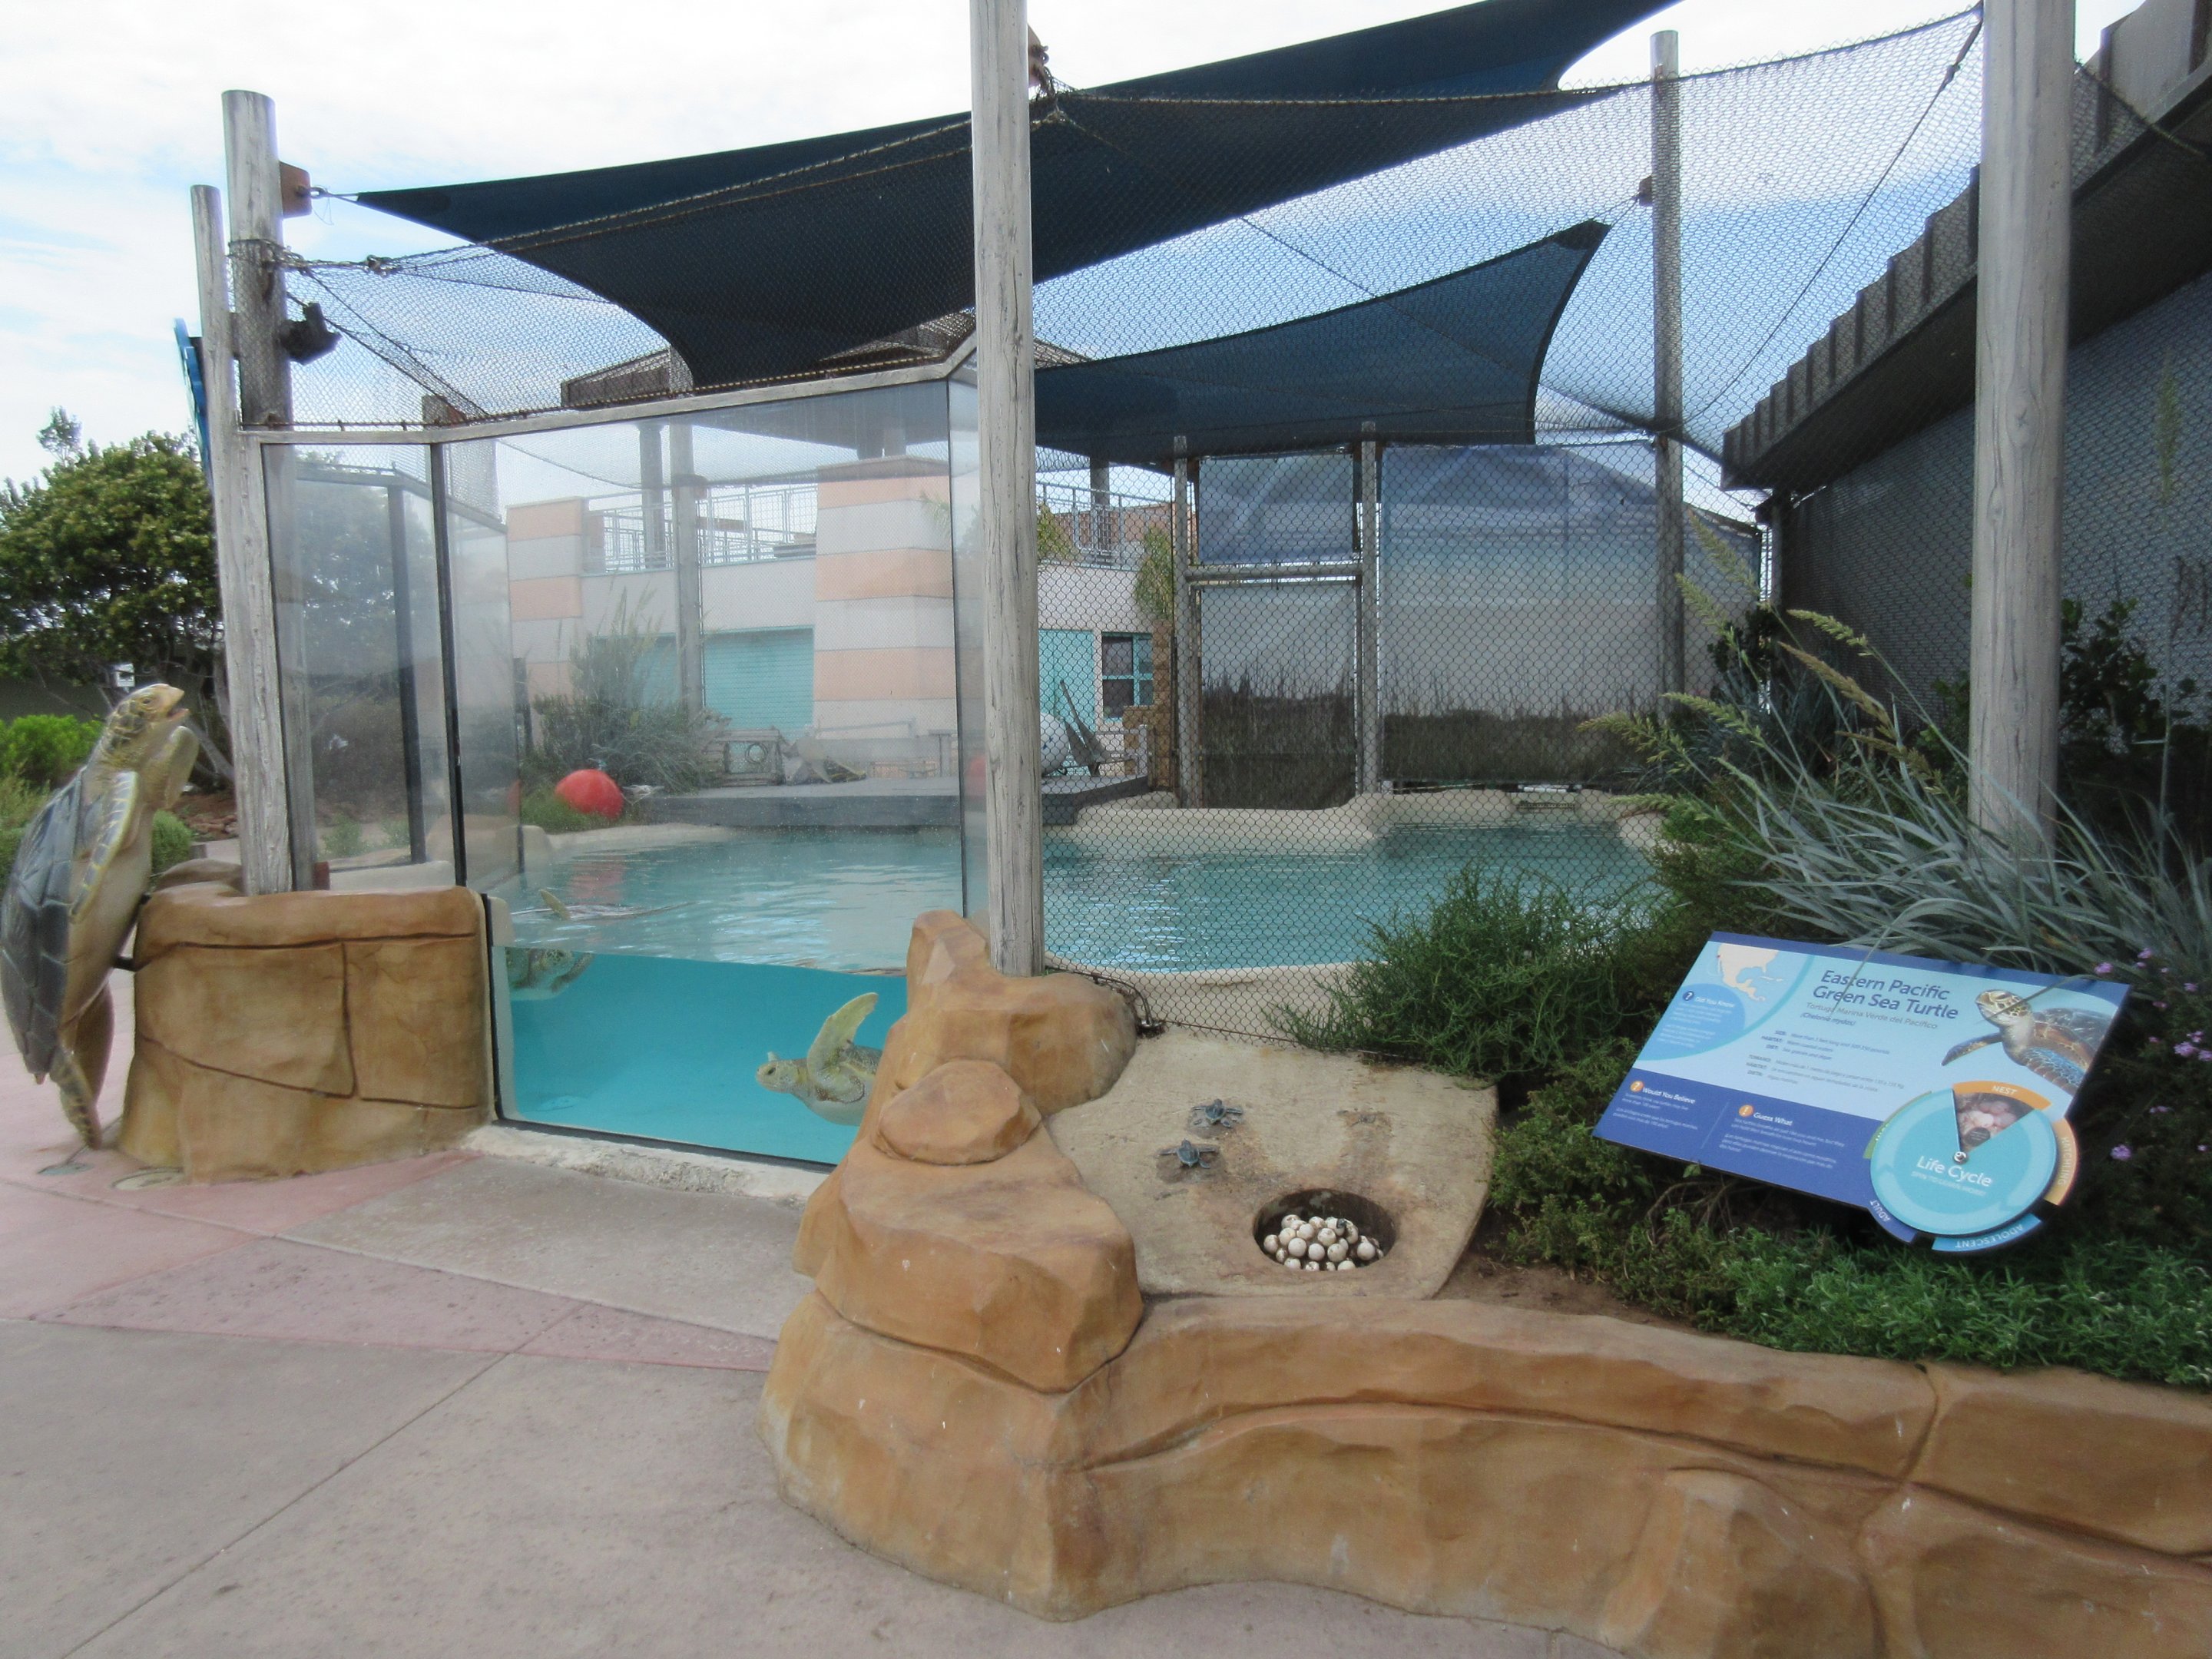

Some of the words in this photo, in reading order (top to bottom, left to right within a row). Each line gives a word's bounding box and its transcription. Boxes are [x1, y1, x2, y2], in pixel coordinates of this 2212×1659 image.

[1821, 970, 1885, 991] Eastern
[1888, 979, 1950, 1000] Pacific
[1813, 985, 1865, 1005] Green
[1868, 994, 1900, 1010] Sea
[1906, 998, 1959, 1019] Turtle
[1838, 1008, 1863, 1018] Marina
[1866, 1012, 1888, 1021] Verde
[1642, 1087, 1661, 1097] Would
[1662, 1091, 1674, 1100] You
[1992, 1085, 2018, 1094] NEST
[1753, 1112, 1773, 1122] Guess
[1774, 1117, 1793, 1127] What
[1916, 1155, 1945, 1174] Life
[1948, 1165, 1993, 1187] Cycle
[2058, 1137, 2072, 1186] HATCHLING
[1869, 1200, 1890, 1222] ADULT
[1954, 1223, 2024, 1249] ADOLESCENT
